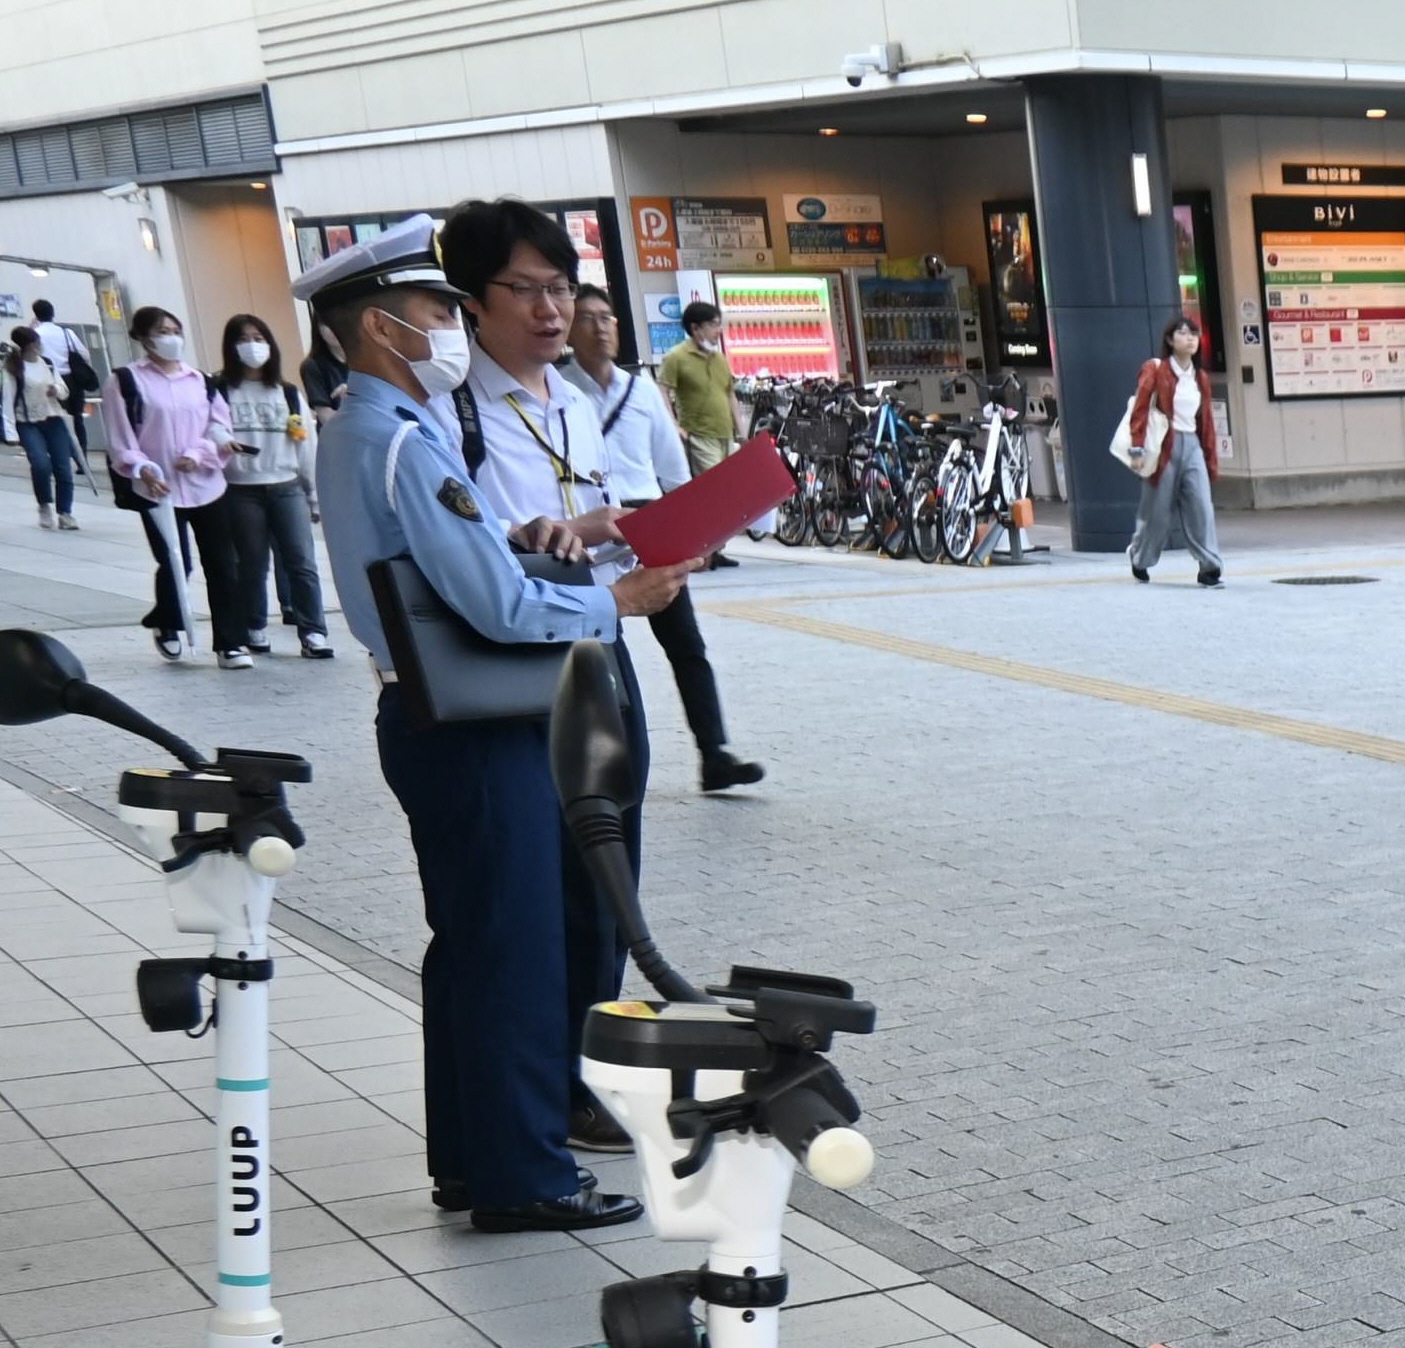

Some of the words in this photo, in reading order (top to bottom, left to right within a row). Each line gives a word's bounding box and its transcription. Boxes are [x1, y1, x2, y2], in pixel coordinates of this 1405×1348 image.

[1306, 168, 1361, 183] 建物設置者
[645, 255, 672, 269] 24h
[231, 1124, 261, 1237] LUUP
